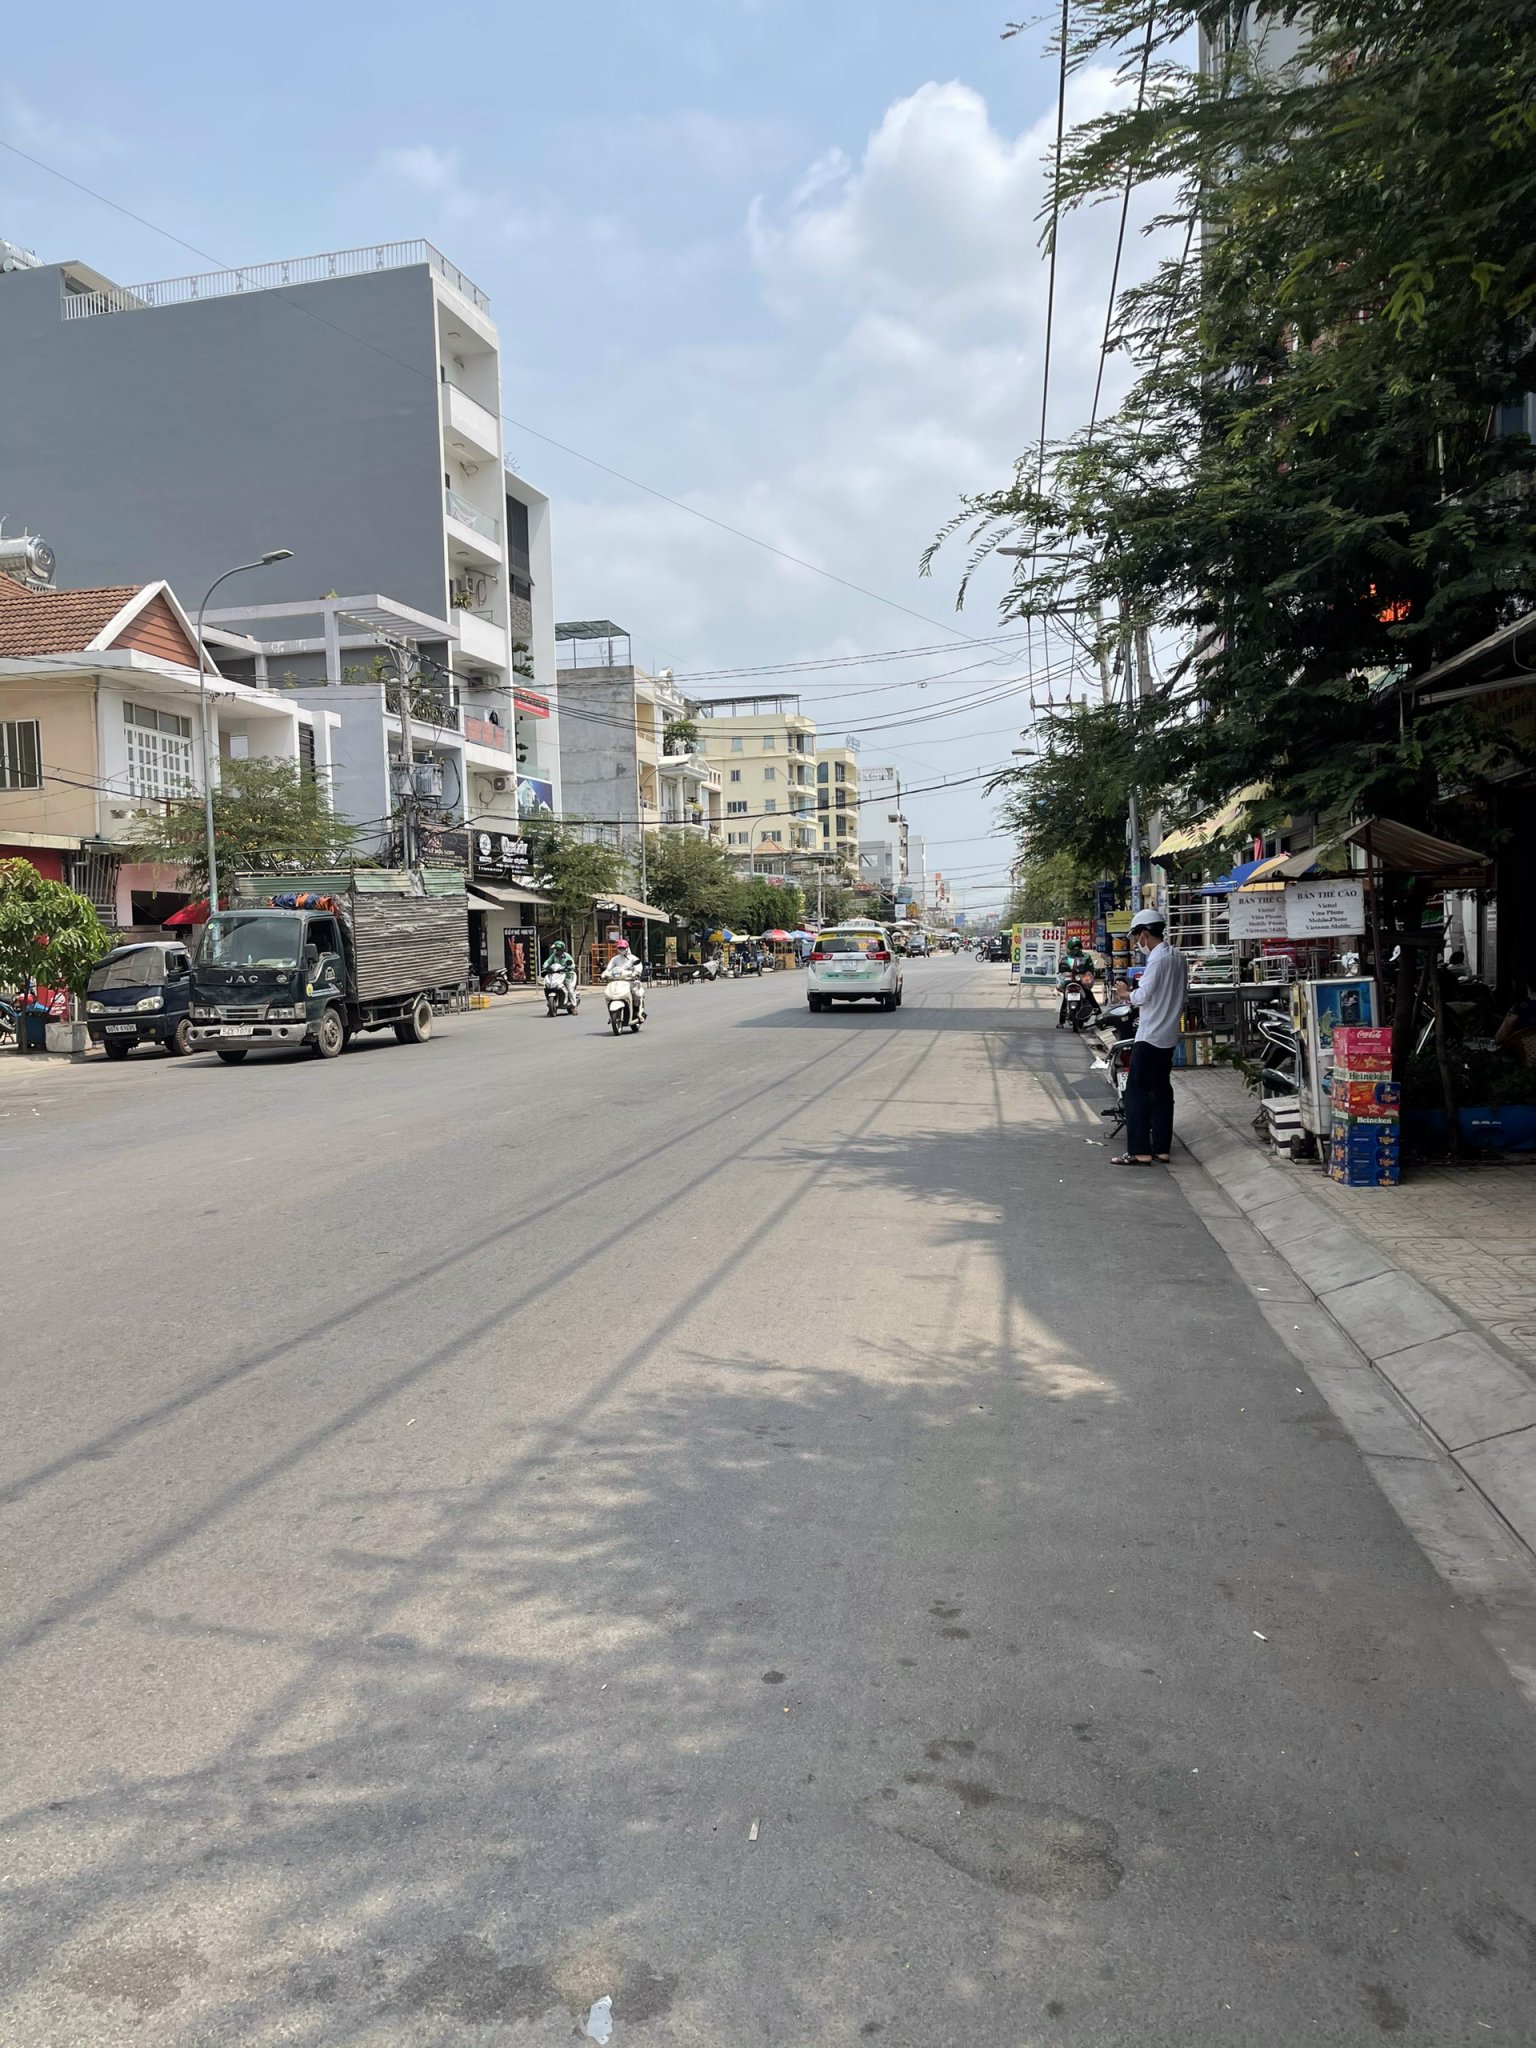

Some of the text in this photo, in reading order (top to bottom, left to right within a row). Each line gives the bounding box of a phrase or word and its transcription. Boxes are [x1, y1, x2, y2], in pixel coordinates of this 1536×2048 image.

[1297, 891, 1315, 900] BÁN
[1042, 929, 1059, 940] 88
[225, 975, 259, 984] JAC
[1349, 1072, 1390, 1080] Heineken
[1381, 1094, 1398, 1103] Tiger
[1356, 1116, 1392, 1124] Heineken
[1378, 1136, 1396, 1145] Tiger
[1379, 1158, 1395, 1167] Tiger
[1378, 1178, 1395, 1187] Tiger
